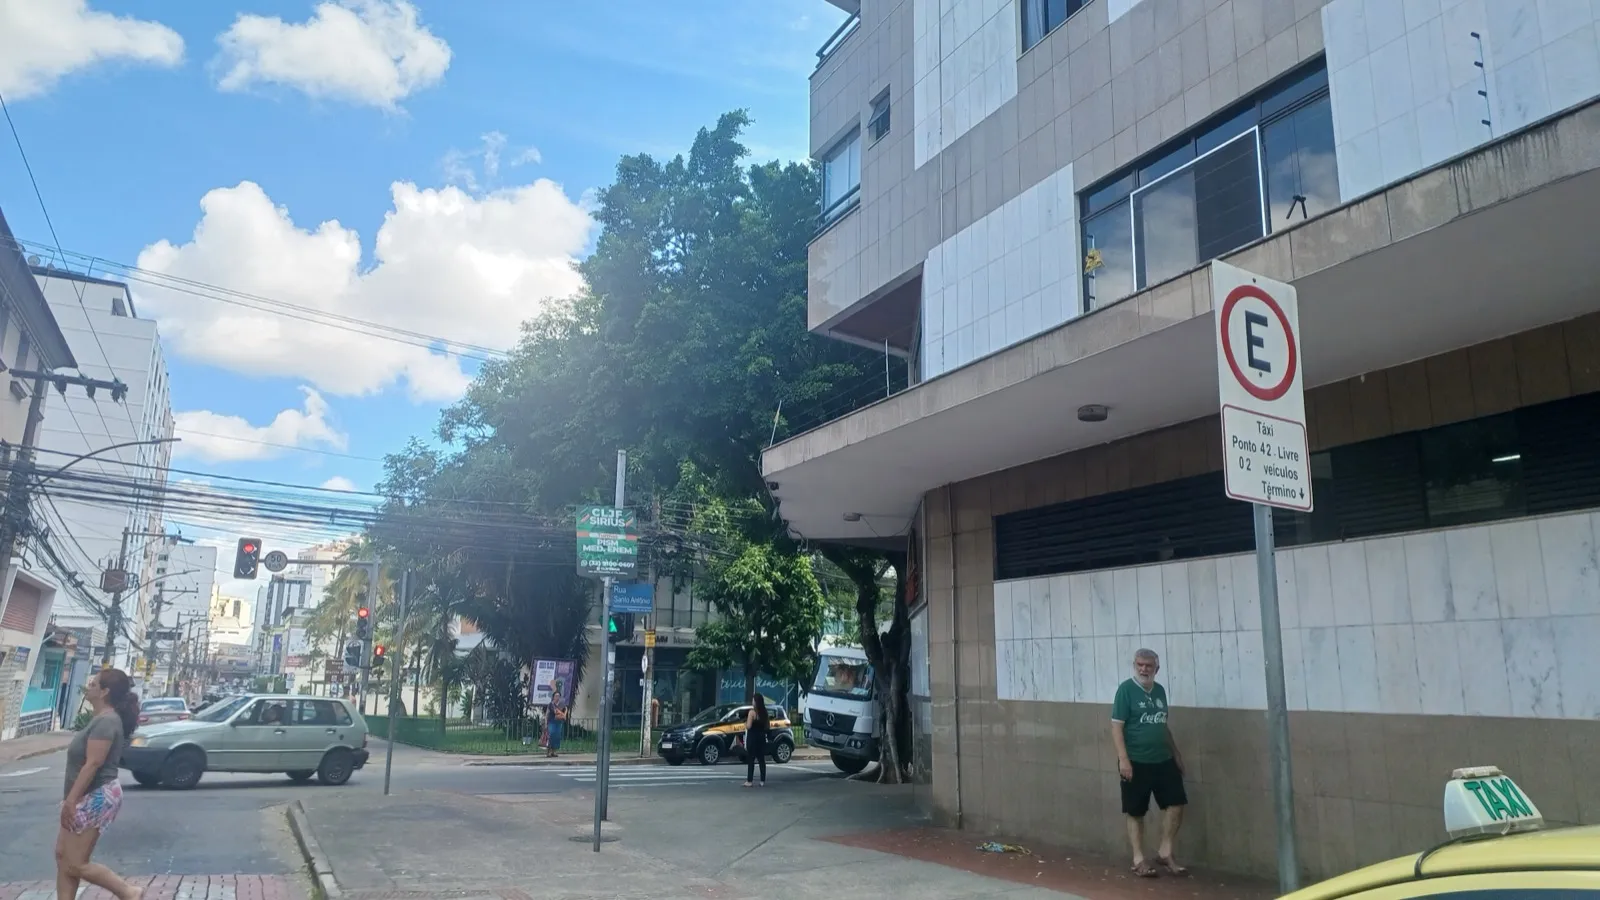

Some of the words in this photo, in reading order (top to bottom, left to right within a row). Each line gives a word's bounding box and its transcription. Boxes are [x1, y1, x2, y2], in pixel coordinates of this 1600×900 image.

[1245, 310, 1271, 373] E
[1257, 421, 1274, 437] Táxi
[1232, 435, 1257, 453] Ponto
[1260, 442, 1272, 457] 42
[1277, 446, 1299, 462] Livre
[1238, 456, 1251, 471] 02
[1264, 463, 1299, 480] veículos
[1262, 480, 1296, 499] Término
[591, 508, 623, 518] CLJF
[589, 517, 626, 527] SIRIUS
[607, 546, 632, 554] ENEM
[613, 585, 627, 593] Rua
[613, 595, 630, 604] Santo
[1463, 778, 1533, 821] TAXI
